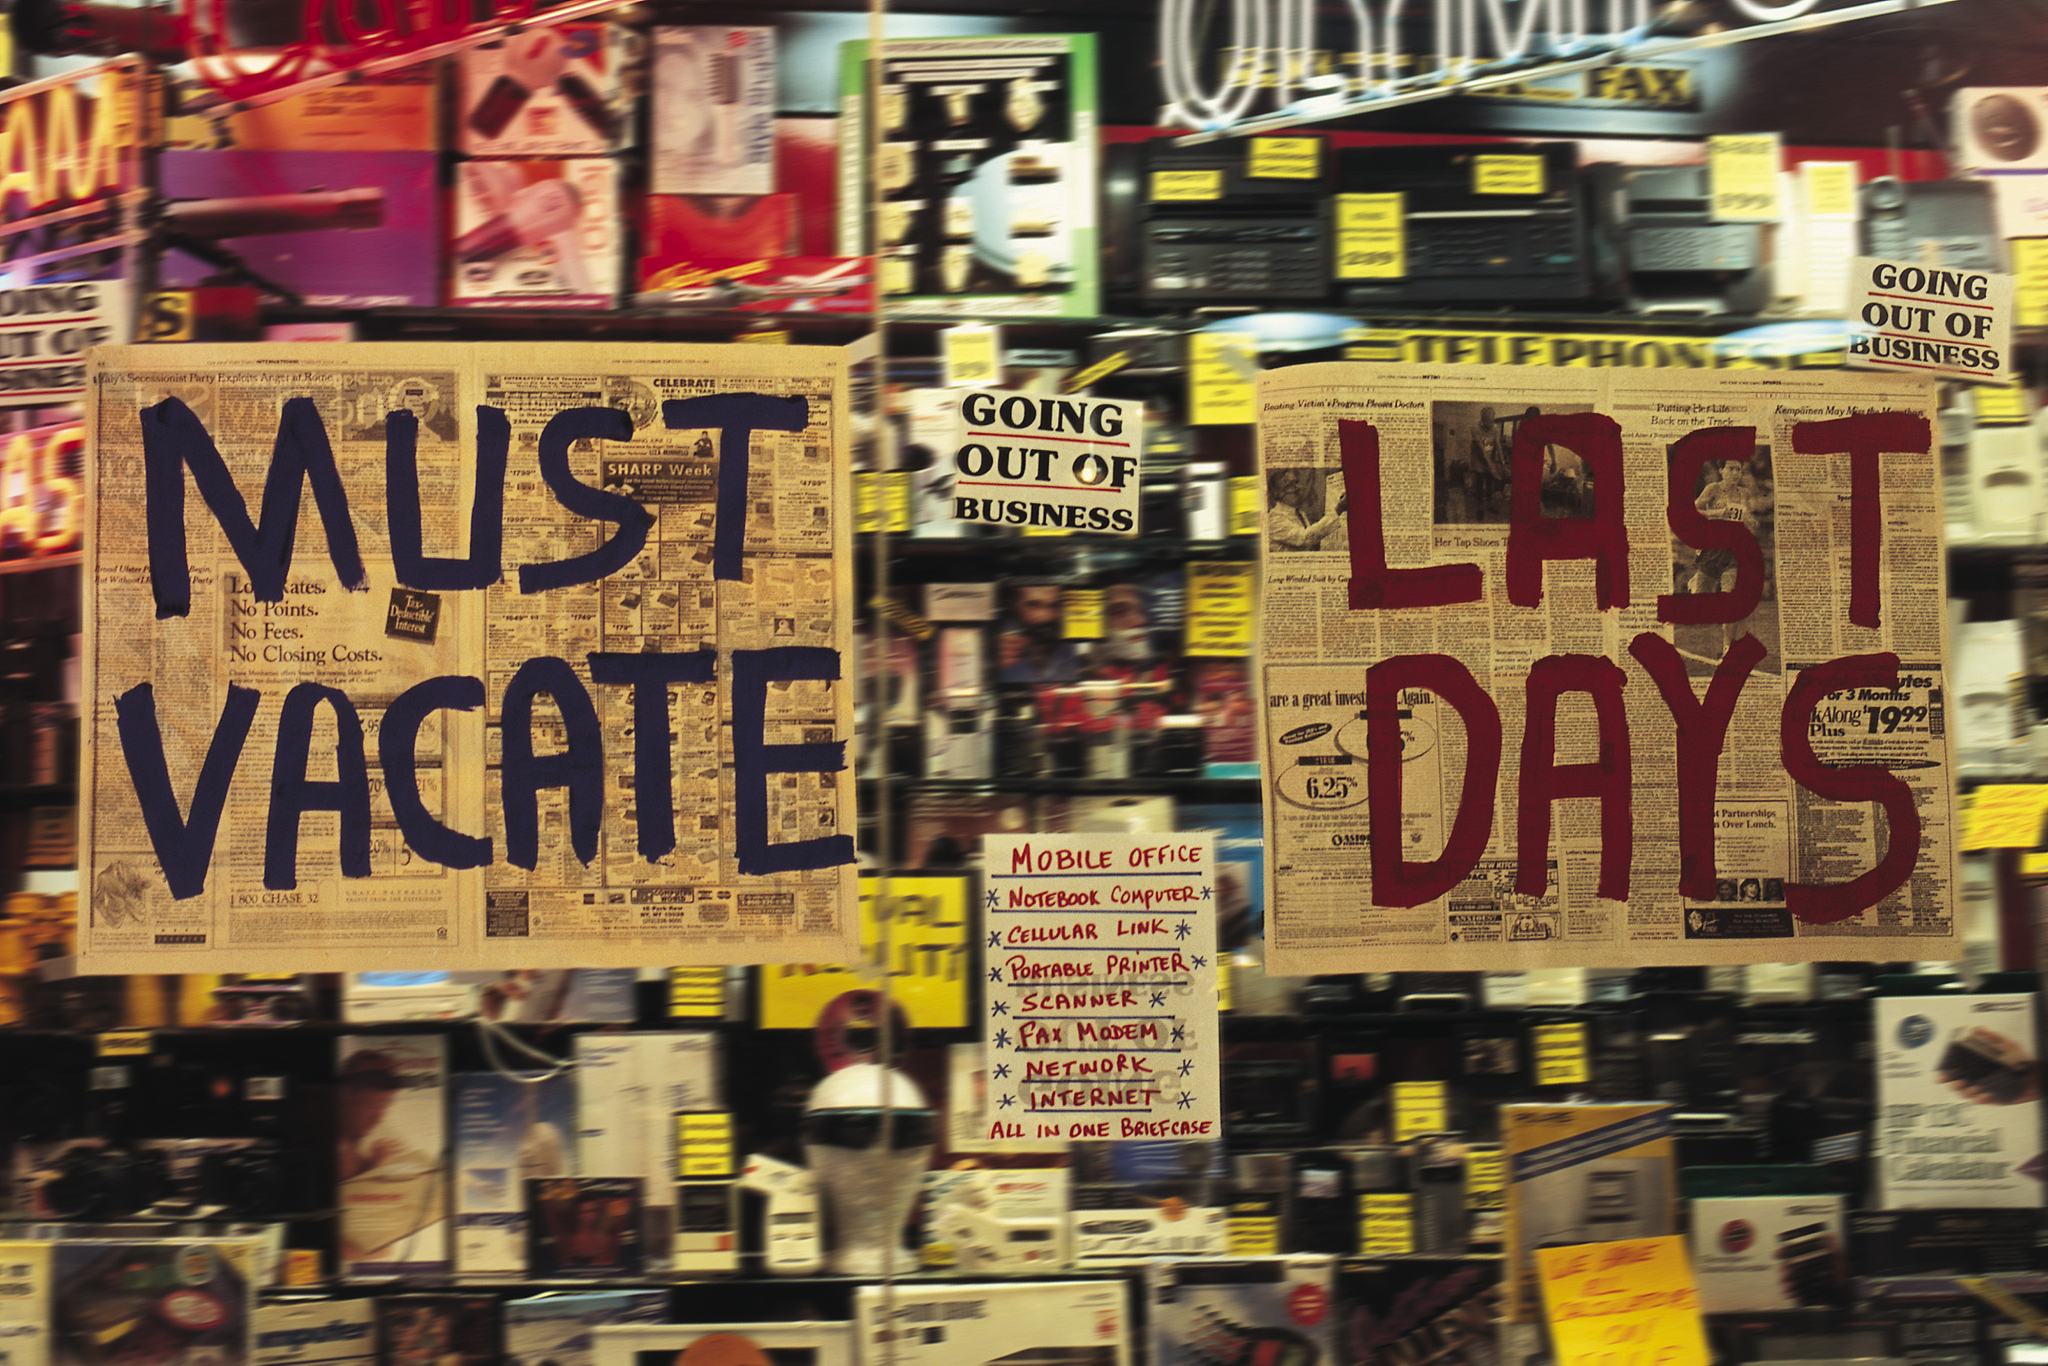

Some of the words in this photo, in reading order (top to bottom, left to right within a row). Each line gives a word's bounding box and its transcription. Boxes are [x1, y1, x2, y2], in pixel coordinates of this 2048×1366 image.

[1589, 66, 1691, 101] FAX
[1872, 263, 1987, 300] GOING
[0, 284, 101, 317] OING
[1861, 302, 1935, 333] OUT
[1945, 312, 1994, 340] OF
[1849, 334, 2000, 370] BUSINESS
[127, 372, 187, 384] Secessionist
[189, 372, 215, 385] Party
[218, 372, 257, 385] Exploits
[260, 372, 290, 385] Anger
[292, 373, 303, 384] at
[305, 372, 333, 384] Rome
[653, 378, 716, 388] CELEBRATE
[962, 393, 1123, 437] GOING
[1263, 402, 1295, 412] Beating
[1298, 398, 1332, 408] Victim's
[1332, 399, 1364, 409] Progress
[1366, 399, 1393, 408] Pleases
[1394, 399, 1425, 408] Doctors
[1656, 403, 1691, 415] Putting
[1693, 403, 1710, 413] Her
[1825, 405, 1845, 416] May
[1651, 416, 1675, 425] Back
[1691, 416, 1705, 426] the
[1708, 416, 1733, 426] Track
[608, 463, 662, 476] SHARP
[669, 462, 712, 476] Week
[957, 443, 1059, 482] OUT
[1072, 453, 1138, 488] OF
[141, 394, 807, 617] MUST
[955, 496, 1134, 532] BUSINESS
[1338, 411, 1931, 629] LAST
[1435, 537, 1452, 547] Her
[1453, 537, 1472, 550] Tap
[1473, 537, 1500, 547] Shoes
[231, 576, 254, 594] Lo
[231, 600, 257, 617] No
[264, 601, 319, 617] Points.
[390, 604, 435, 623] Deductible
[231, 622, 257, 640] No
[264, 622, 304, 640] Fees.
[395, 619, 425, 634] Interest
[230, 645, 256, 663] No
[263, 644, 326, 666] Closing
[332, 644, 383, 663] Costs.
[1900, 674, 1933, 689] utes
[1270, 695, 1288, 708] are
[1292, 696, 1299, 707] a
[1302, 692, 1331, 710] great
[1335, 690, 1367, 706] invest
[1402, 689, 1434, 709] Again.
[1822, 690, 1842, 701] or
[1845, 690, 1856, 701] 3
[1859, 689, 1912, 701] Months
[1811, 704, 1861, 727] kAlong
[1810, 723, 1846, 737] Plus
[116, 647, 856, 899] VACATE
[1366, 631, 1921, 924] DAYS
[1306, 776, 1358, 799] 6.25%
[1722, 809, 1776, 821] Partnerships
[1722, 820, 1743, 828] Over
[1746, 819, 1777, 828] Lunch.
[1012, 843, 1112, 874] MOBILE
[1129, 845, 1203, 868] OFFICE
[239, 894, 258, 904] 800
[262, 893, 302, 904] CHASE
[308, 893, 319, 904] 32
[1009, 886, 1100, 909] NOTEBOOK
[1111, 885, 1200, 910] COMPUTER
[1007, 923, 1098, 944] CELLULAR
[1117, 919, 1168, 937] LINK
[1005, 955, 1094, 981] PORTABLE
[1022, 990, 1138, 1012] SCANNER
[1019, 1021, 1062, 1048] FAX
[1077, 1022, 1158, 1042] MODEM
[1026, 1053, 1153, 1080] NETWORK
[1031, 1087, 1162, 1110] INTERNET
[990, 1121, 1026, 1139] ALL
[1037, 1124, 1059, 1137] IN
[1069, 1122, 1110, 1138] ONE
[1121, 1117, 1213, 1138] BRIEFCASE
